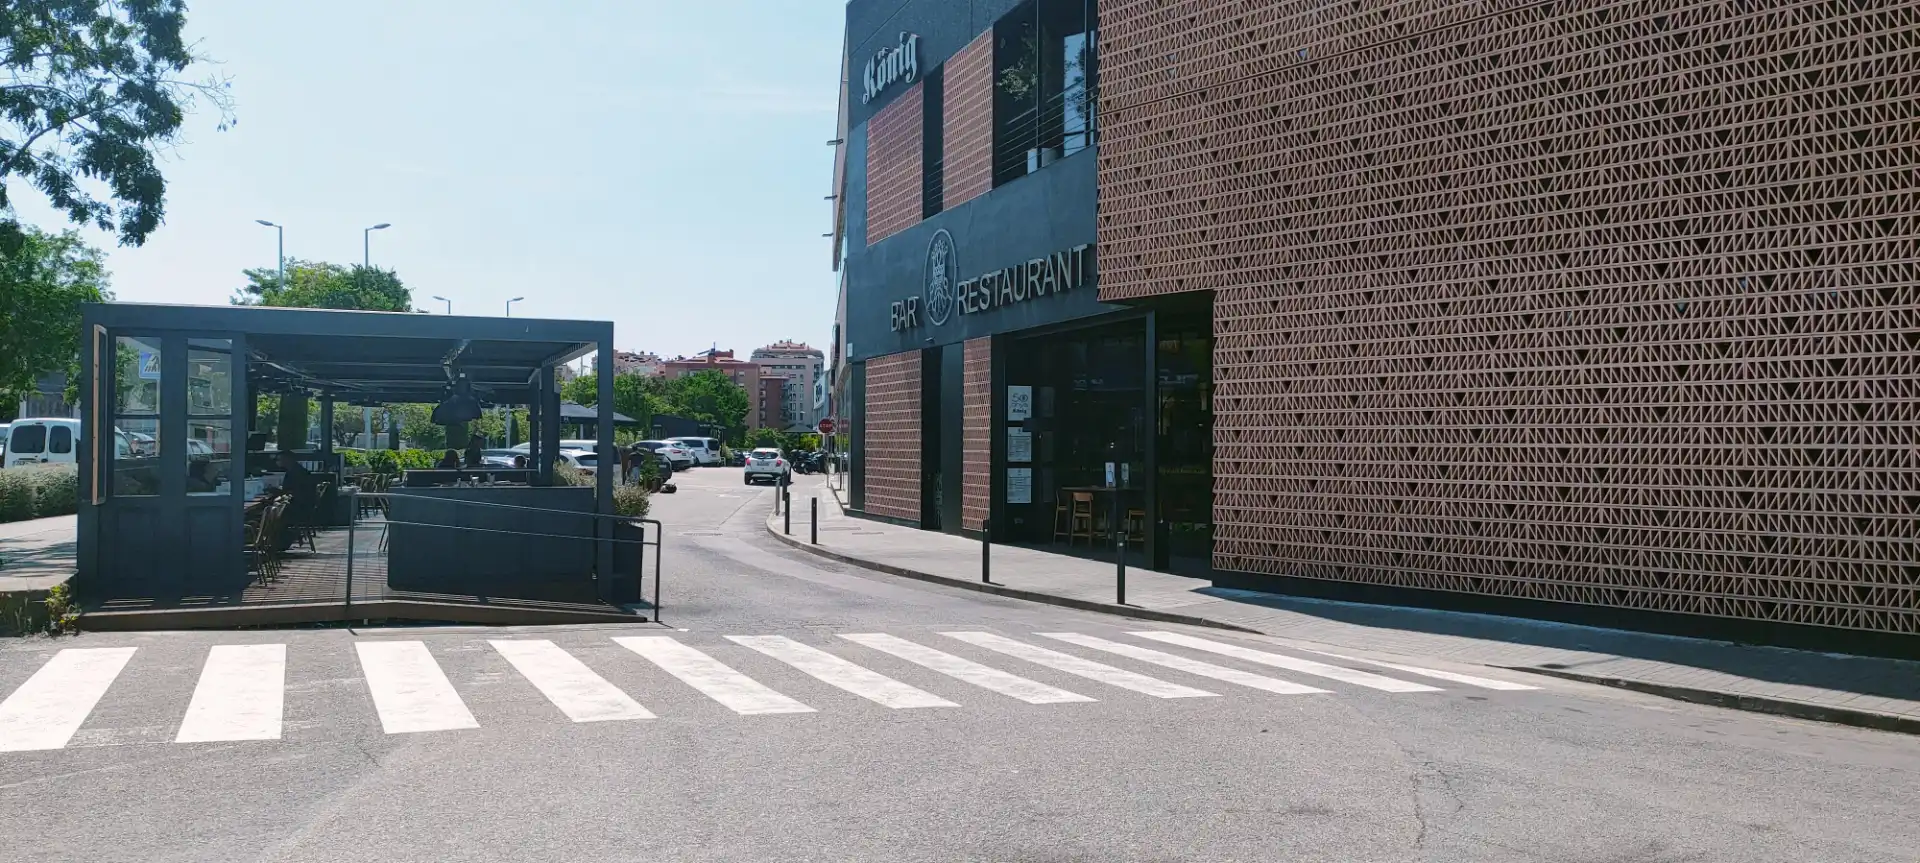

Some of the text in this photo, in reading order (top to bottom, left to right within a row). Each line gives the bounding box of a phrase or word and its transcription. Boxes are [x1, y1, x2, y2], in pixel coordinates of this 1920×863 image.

[862, 31, 919, 105] König
[890, 243, 1088, 333] BAR RESTAURANT
